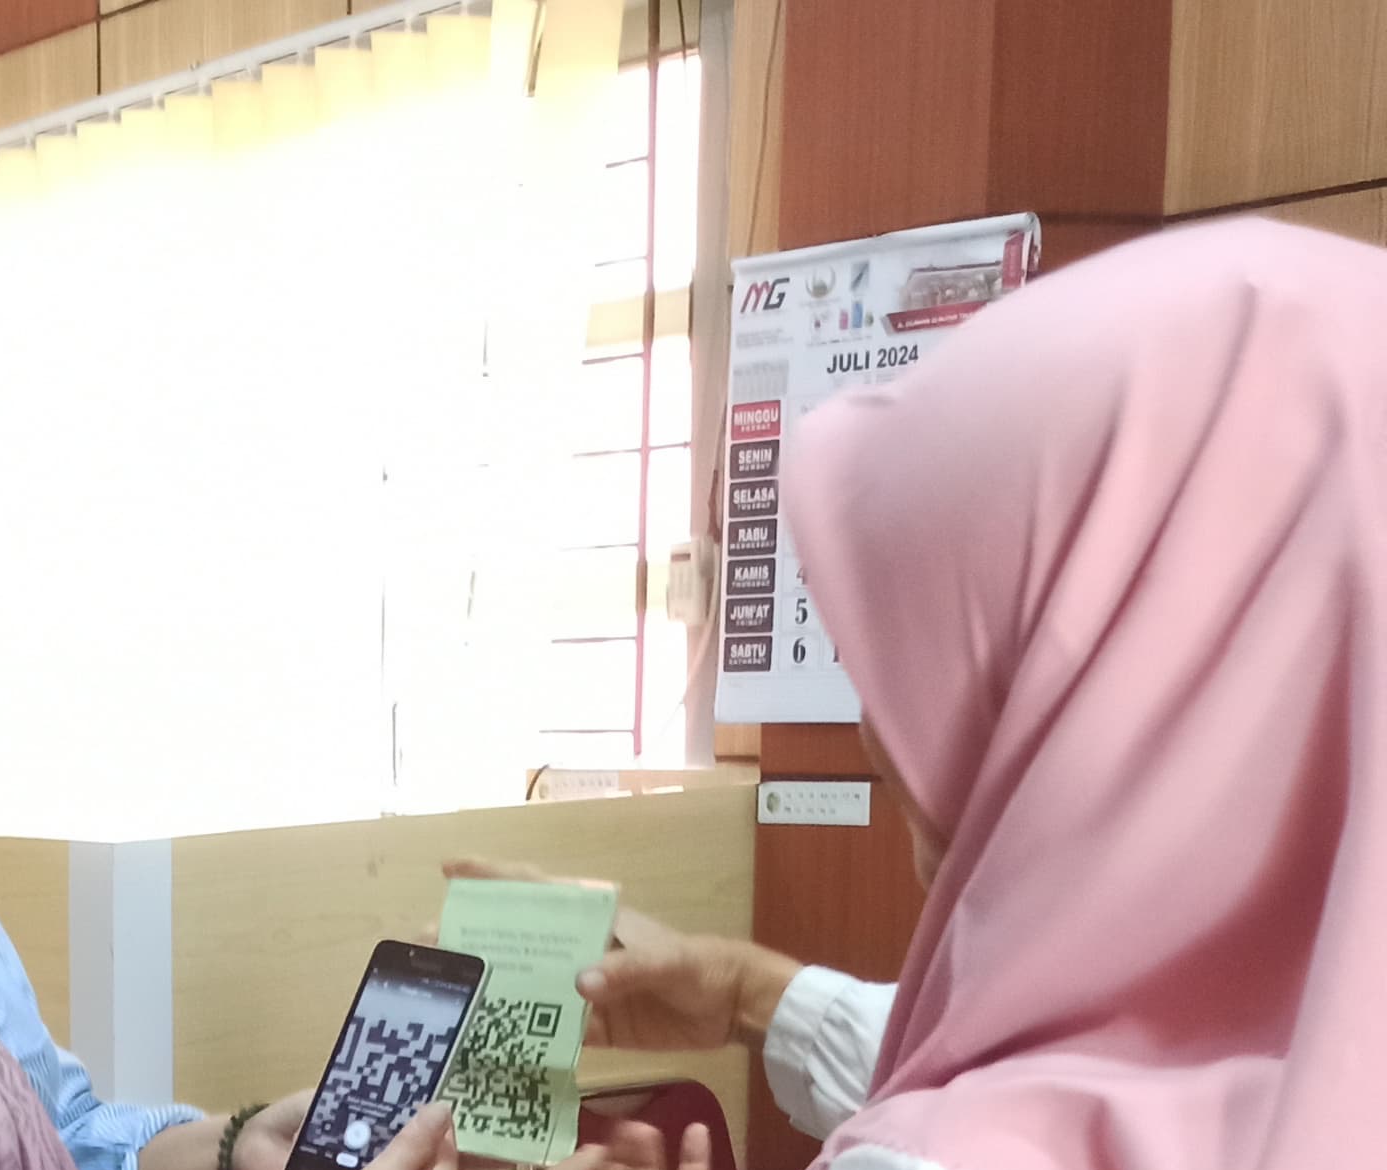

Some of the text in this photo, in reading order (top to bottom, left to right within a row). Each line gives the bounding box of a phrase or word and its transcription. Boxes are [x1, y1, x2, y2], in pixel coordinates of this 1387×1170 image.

[827, 343, 919, 374] JULI 2024
[734, 407, 779, 426] MINGGU
[738, 448, 773, 465] SENIN
[733, 486, 776, 505] SELASA
[738, 526, 768, 542] RABU
[734, 564, 770, 581] KAMIS
[730, 604, 771, 621] JUM'AT
[795, 598, 808, 625] 5
[730, 643, 767, 659] SABTU
[793, 637, 806, 664] 6
